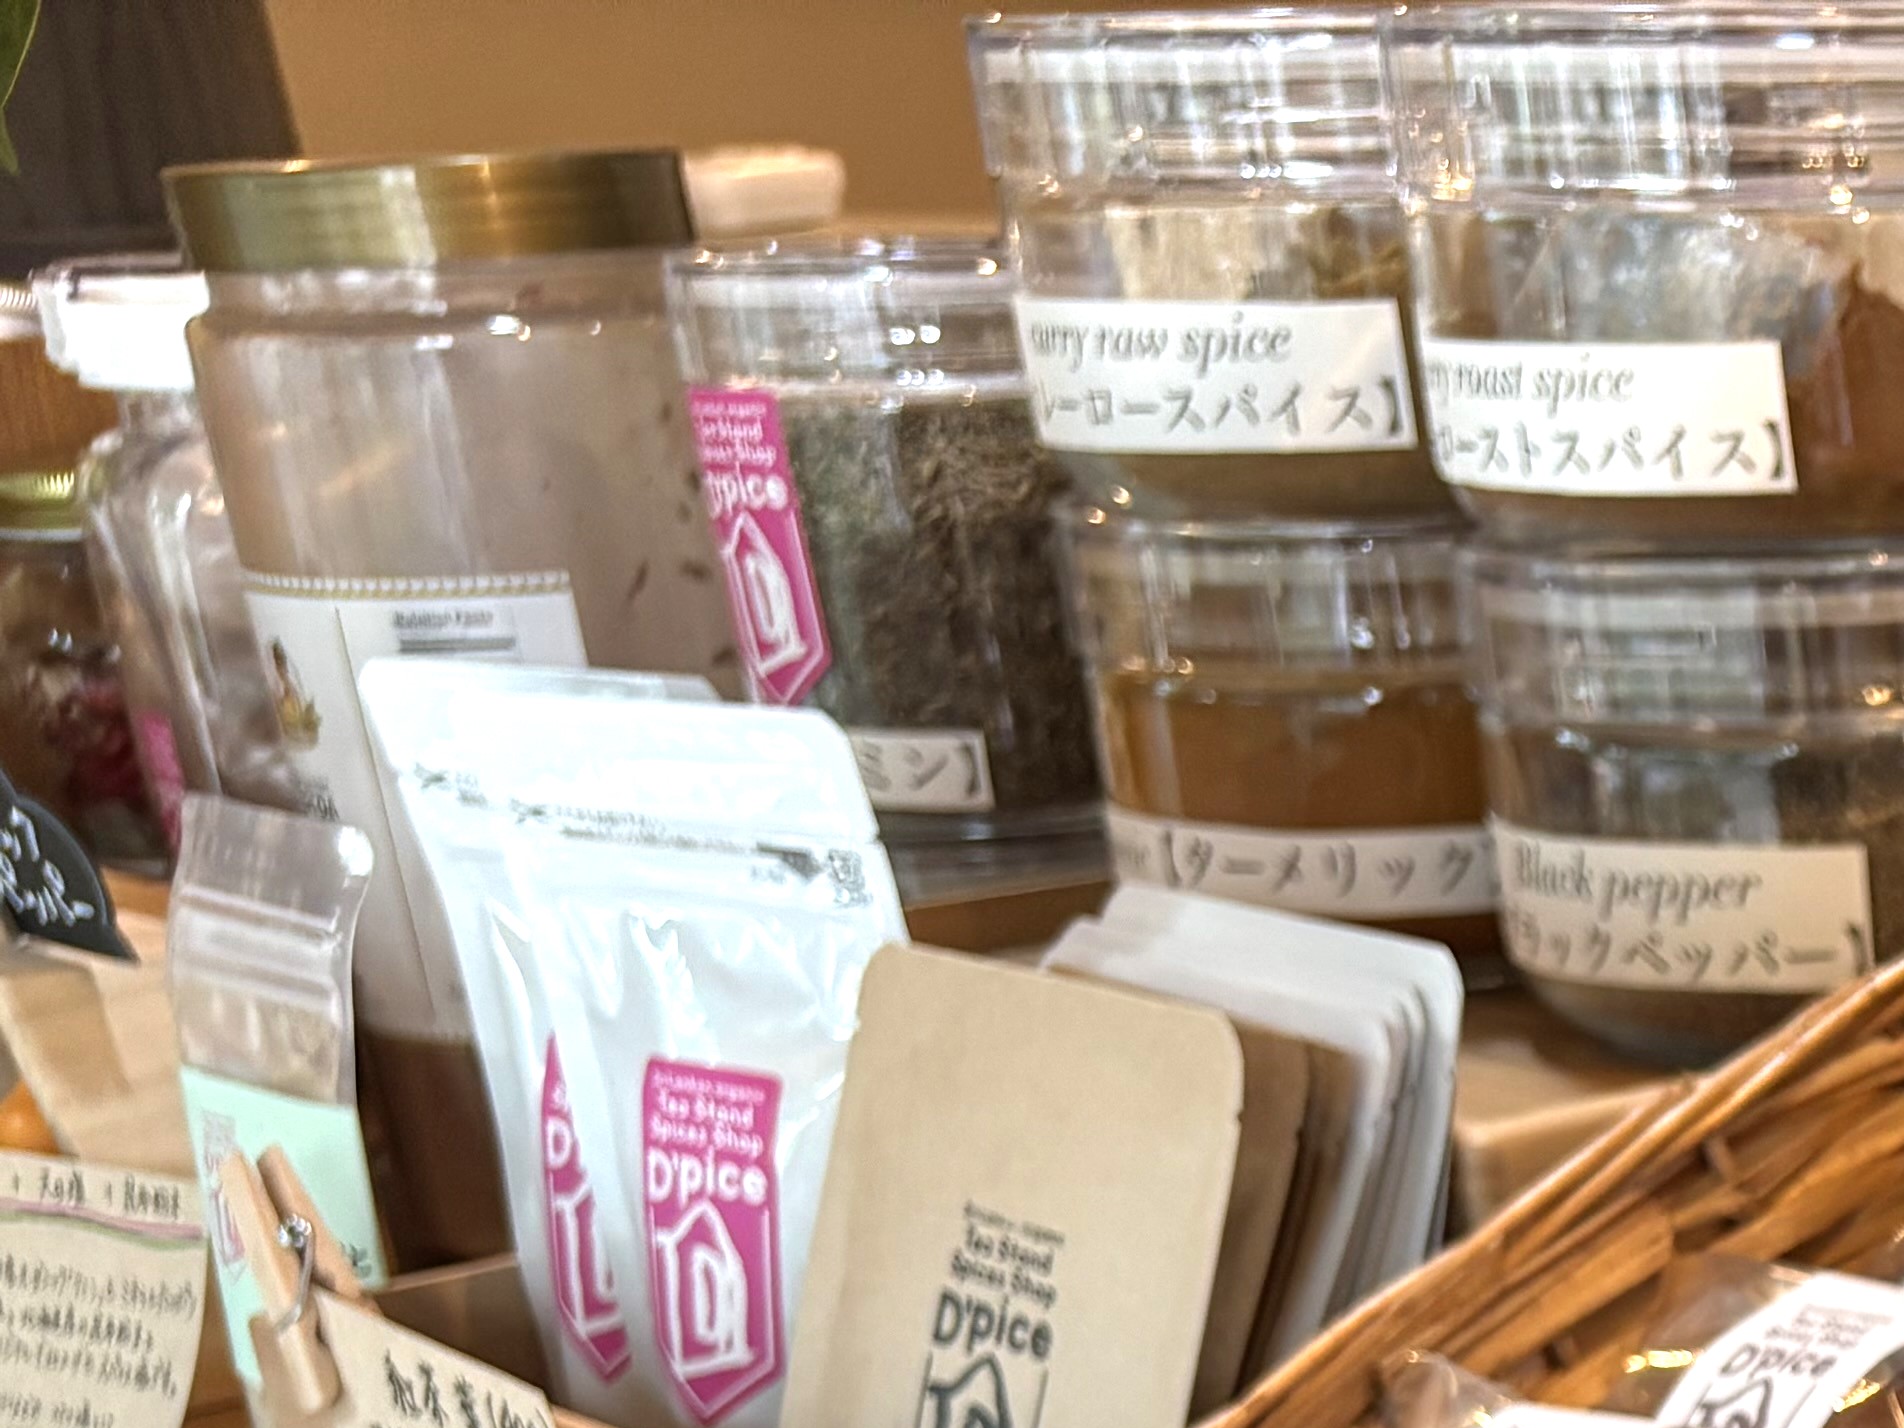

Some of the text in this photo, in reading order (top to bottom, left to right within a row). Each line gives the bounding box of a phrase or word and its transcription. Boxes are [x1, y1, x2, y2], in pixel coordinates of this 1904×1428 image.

[1100, 324, 1168, 362] raw
[1179, 310, 1292, 379] spice
[1532, 352, 1635, 419] spice
[1599, 868, 1763, 927] pepper
[647, 1146, 769, 1208] D'pice
[932, 1284, 1053, 1362] D'pice
